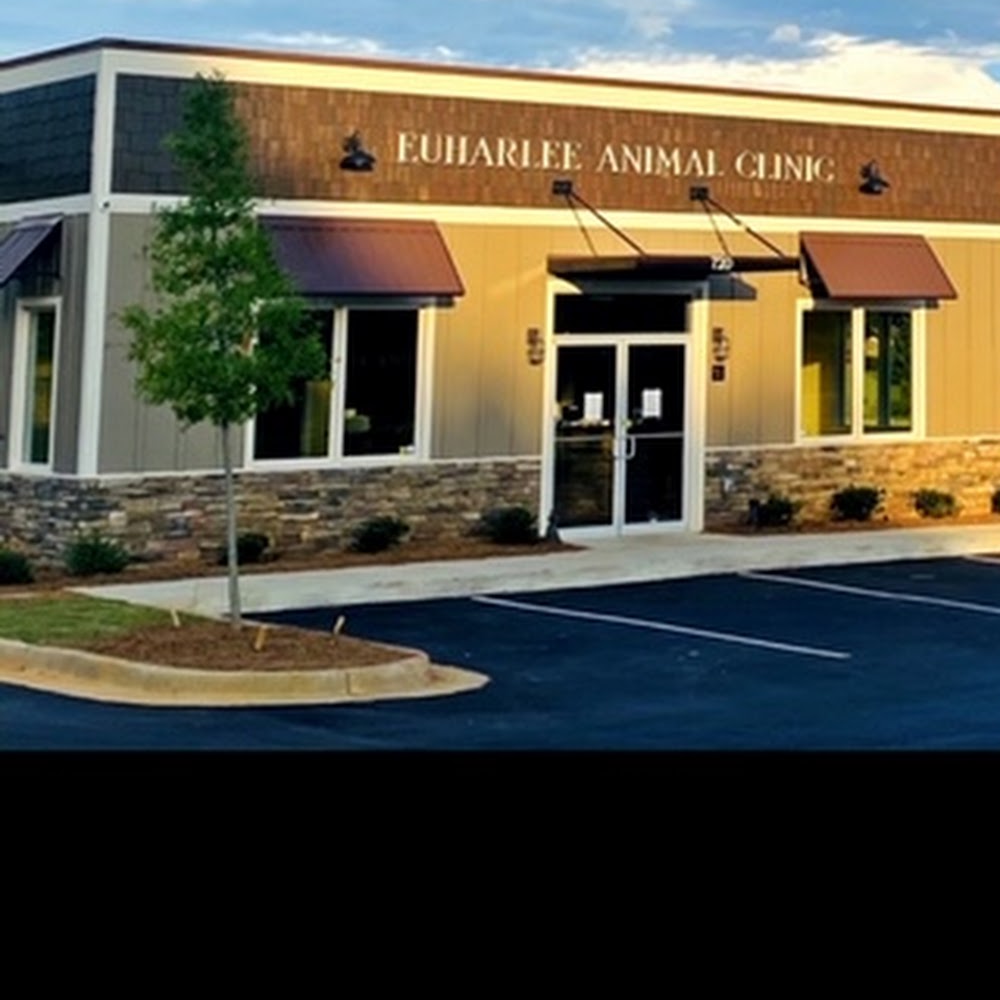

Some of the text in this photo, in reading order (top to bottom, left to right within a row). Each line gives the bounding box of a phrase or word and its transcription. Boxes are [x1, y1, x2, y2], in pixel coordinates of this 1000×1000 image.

[397, 131, 835, 183] EUHARLEE ANIMAL CLINIC
